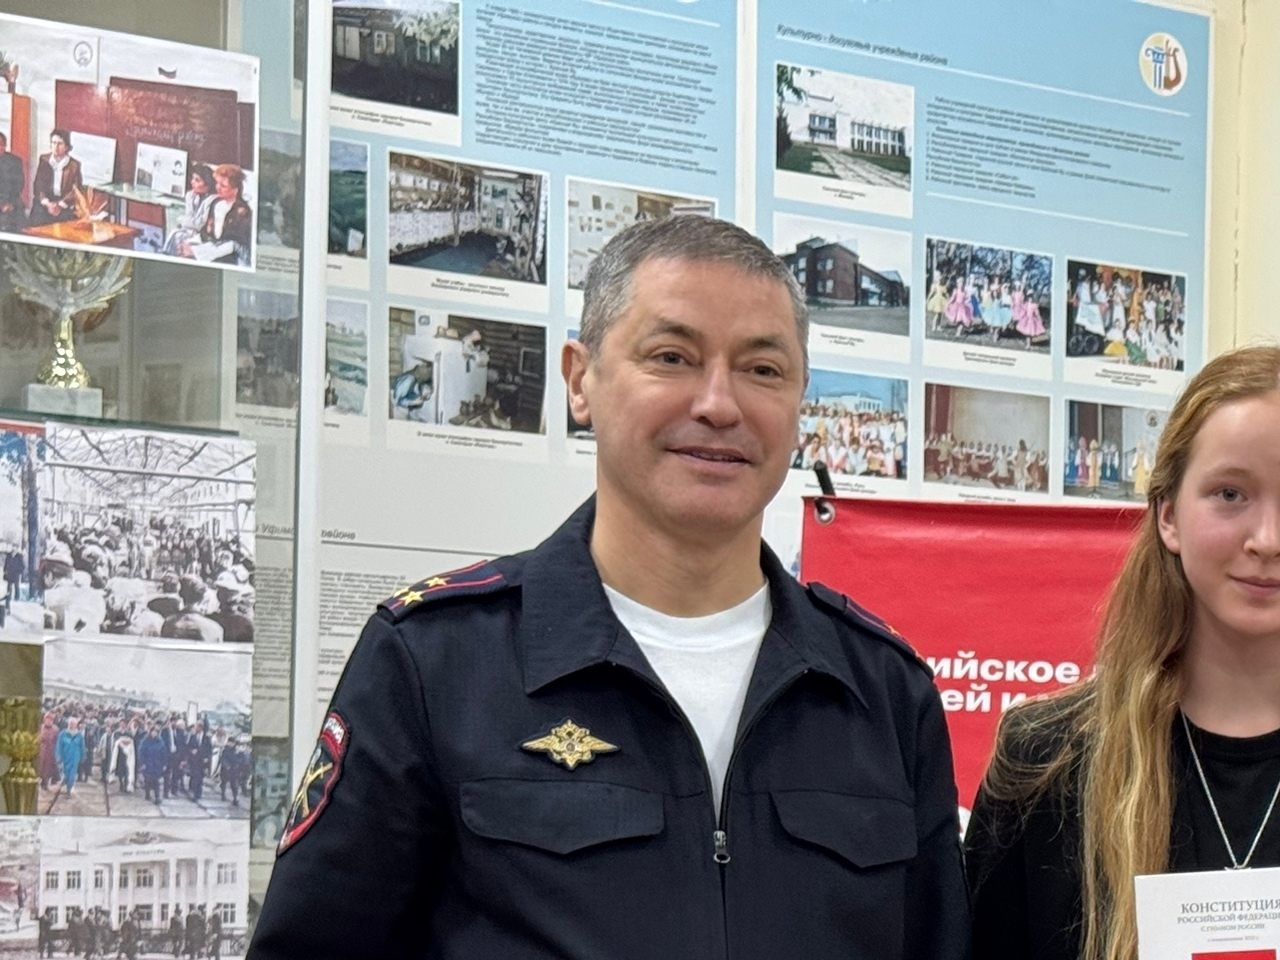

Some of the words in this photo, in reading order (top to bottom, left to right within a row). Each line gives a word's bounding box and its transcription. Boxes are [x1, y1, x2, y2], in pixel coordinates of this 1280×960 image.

[925, 650, 1081, 684] ийское
[941, 683, 992, 713] ей
[1177, 913, 1236, 925] РОССИЙСКОЙ
